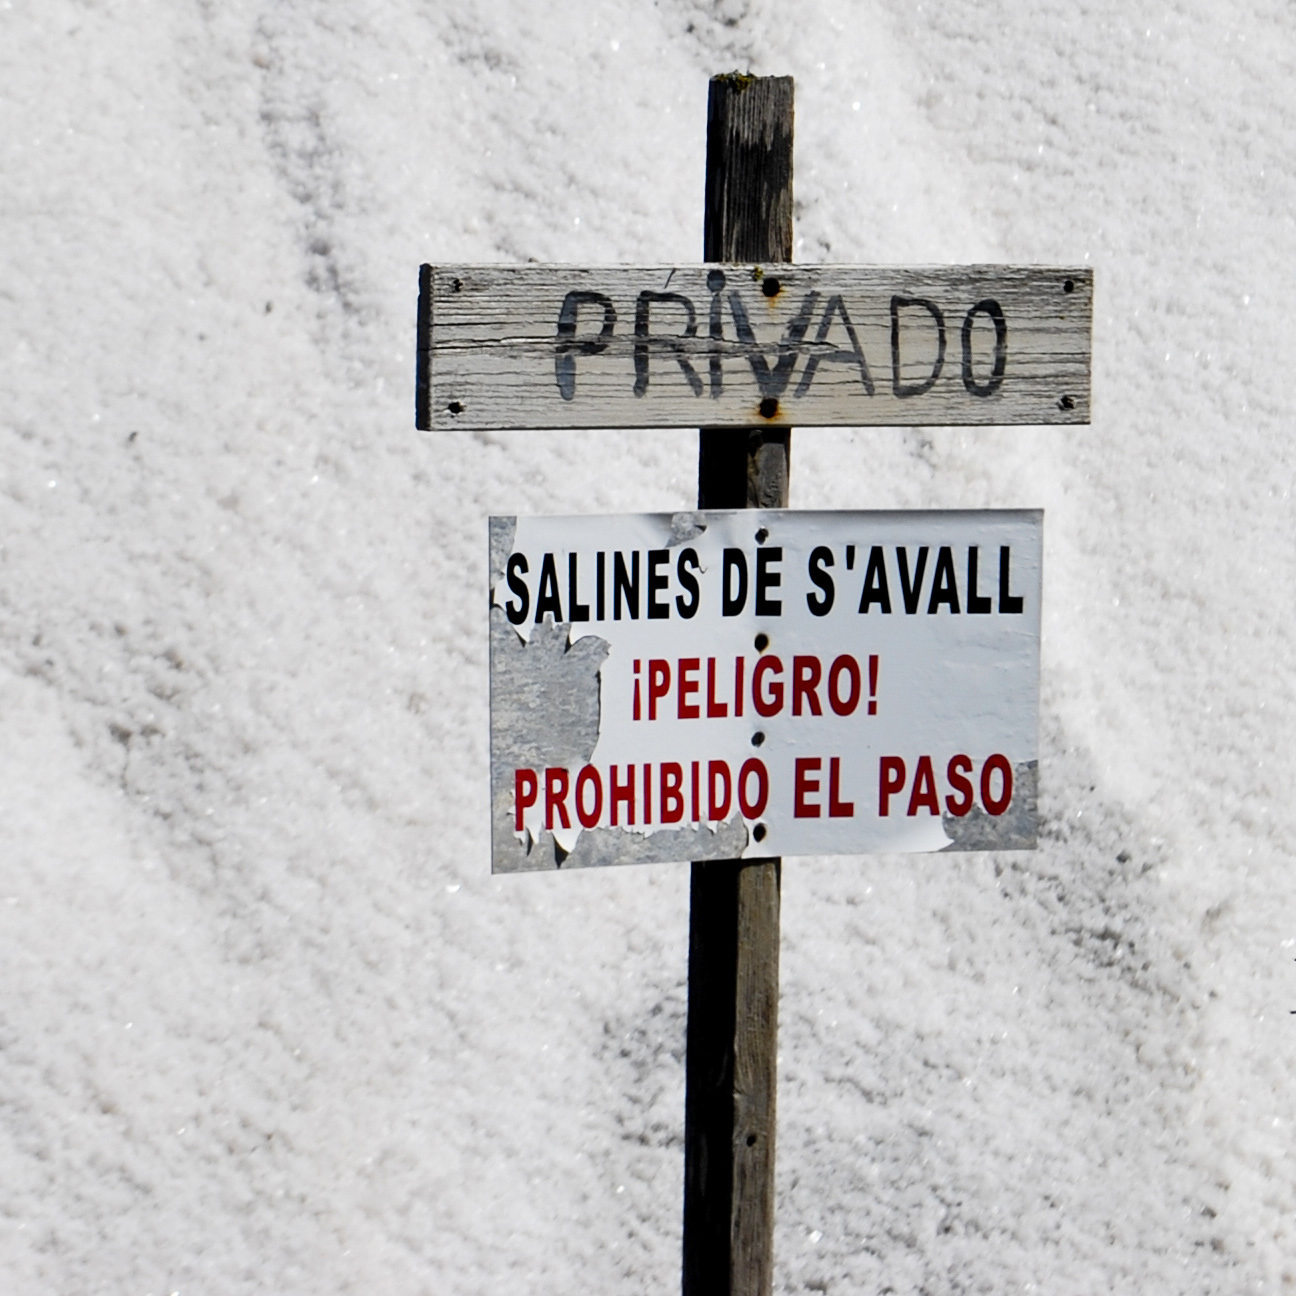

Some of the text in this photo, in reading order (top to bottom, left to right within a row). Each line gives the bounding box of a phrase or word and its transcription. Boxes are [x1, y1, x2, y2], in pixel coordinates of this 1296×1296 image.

[505, 545, 1024, 625] SALINES DE S'AVALL
[632, 654, 879, 721] ¡PELIGRO!
[514, 753, 1013, 832] PROHIBIDO EL PASO
